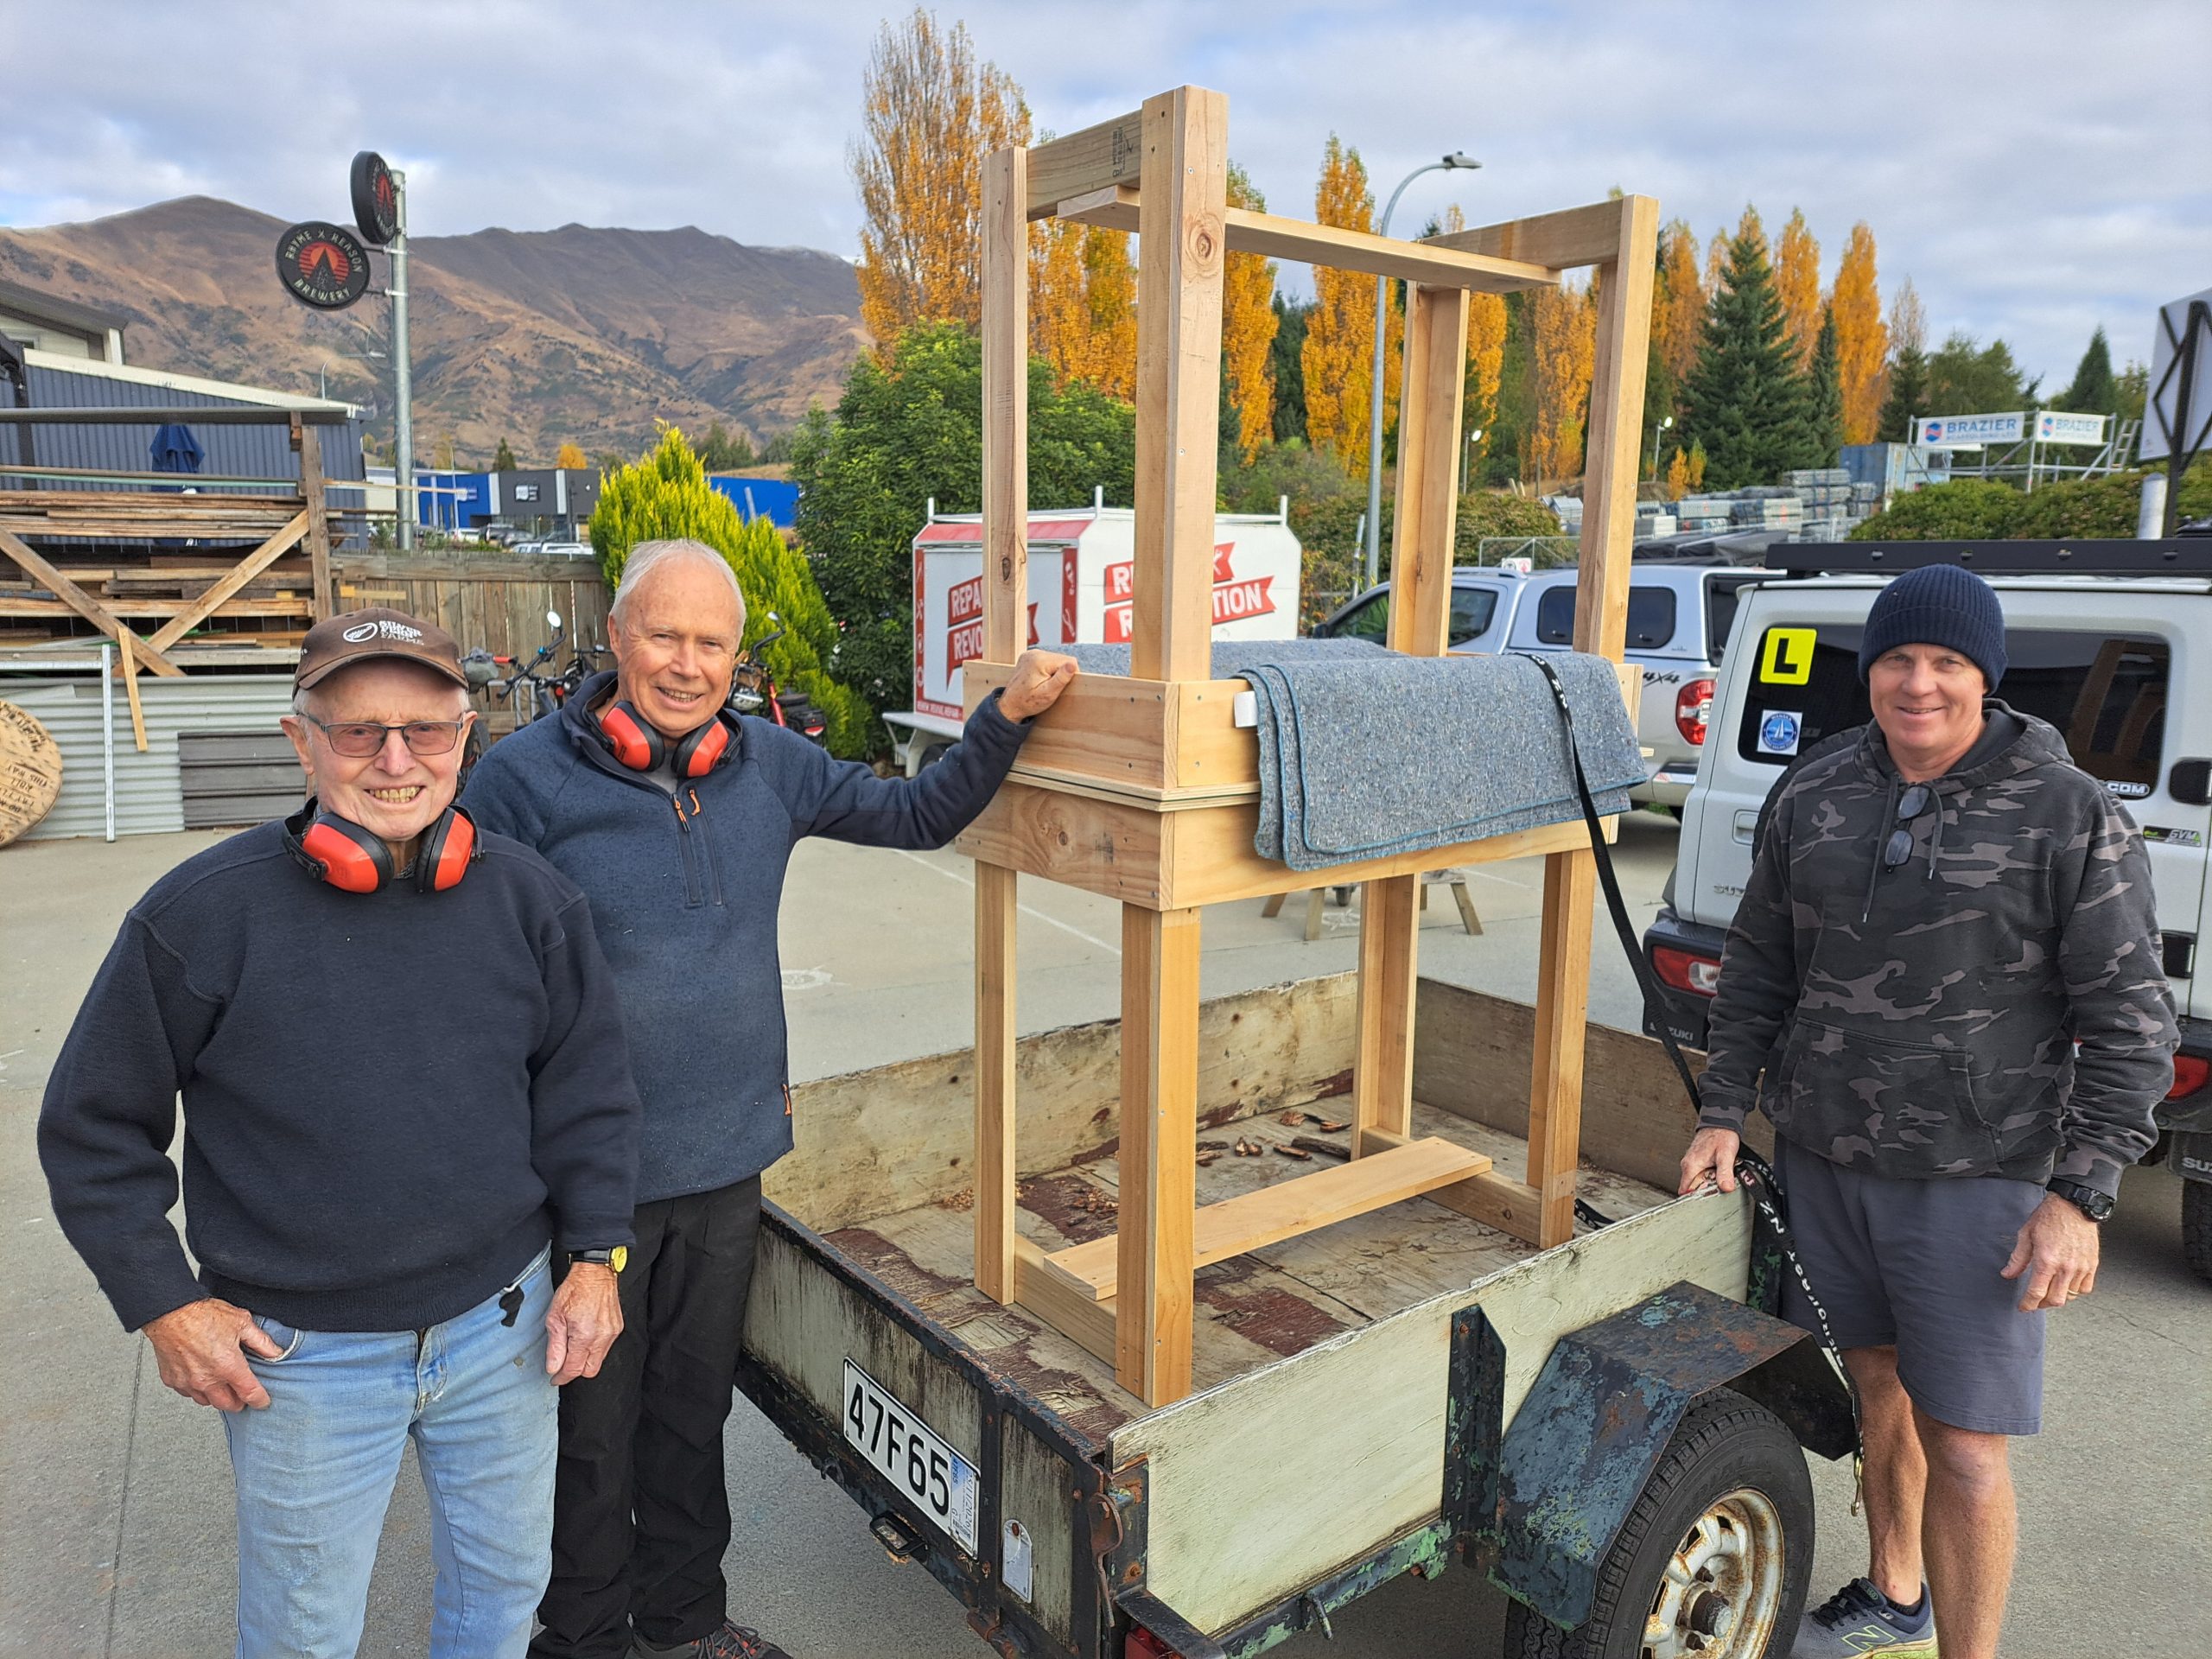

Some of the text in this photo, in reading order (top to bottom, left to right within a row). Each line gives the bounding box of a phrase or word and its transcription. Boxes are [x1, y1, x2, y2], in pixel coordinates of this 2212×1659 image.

[284, 230, 312, 260] RHYME
[331, 232, 363, 273] REASON
[294, 277, 350, 302] BREWERY
[1947, 418, 2017, 433] BRAZIER
[2056, 418, 2099, 432] BRAZIER
[950, 580, 982, 618] REPA
[1773, 638, 1798, 674] L
[2106, 782, 2146, 794] COM
[849, 1382, 950, 1516] 47F65
